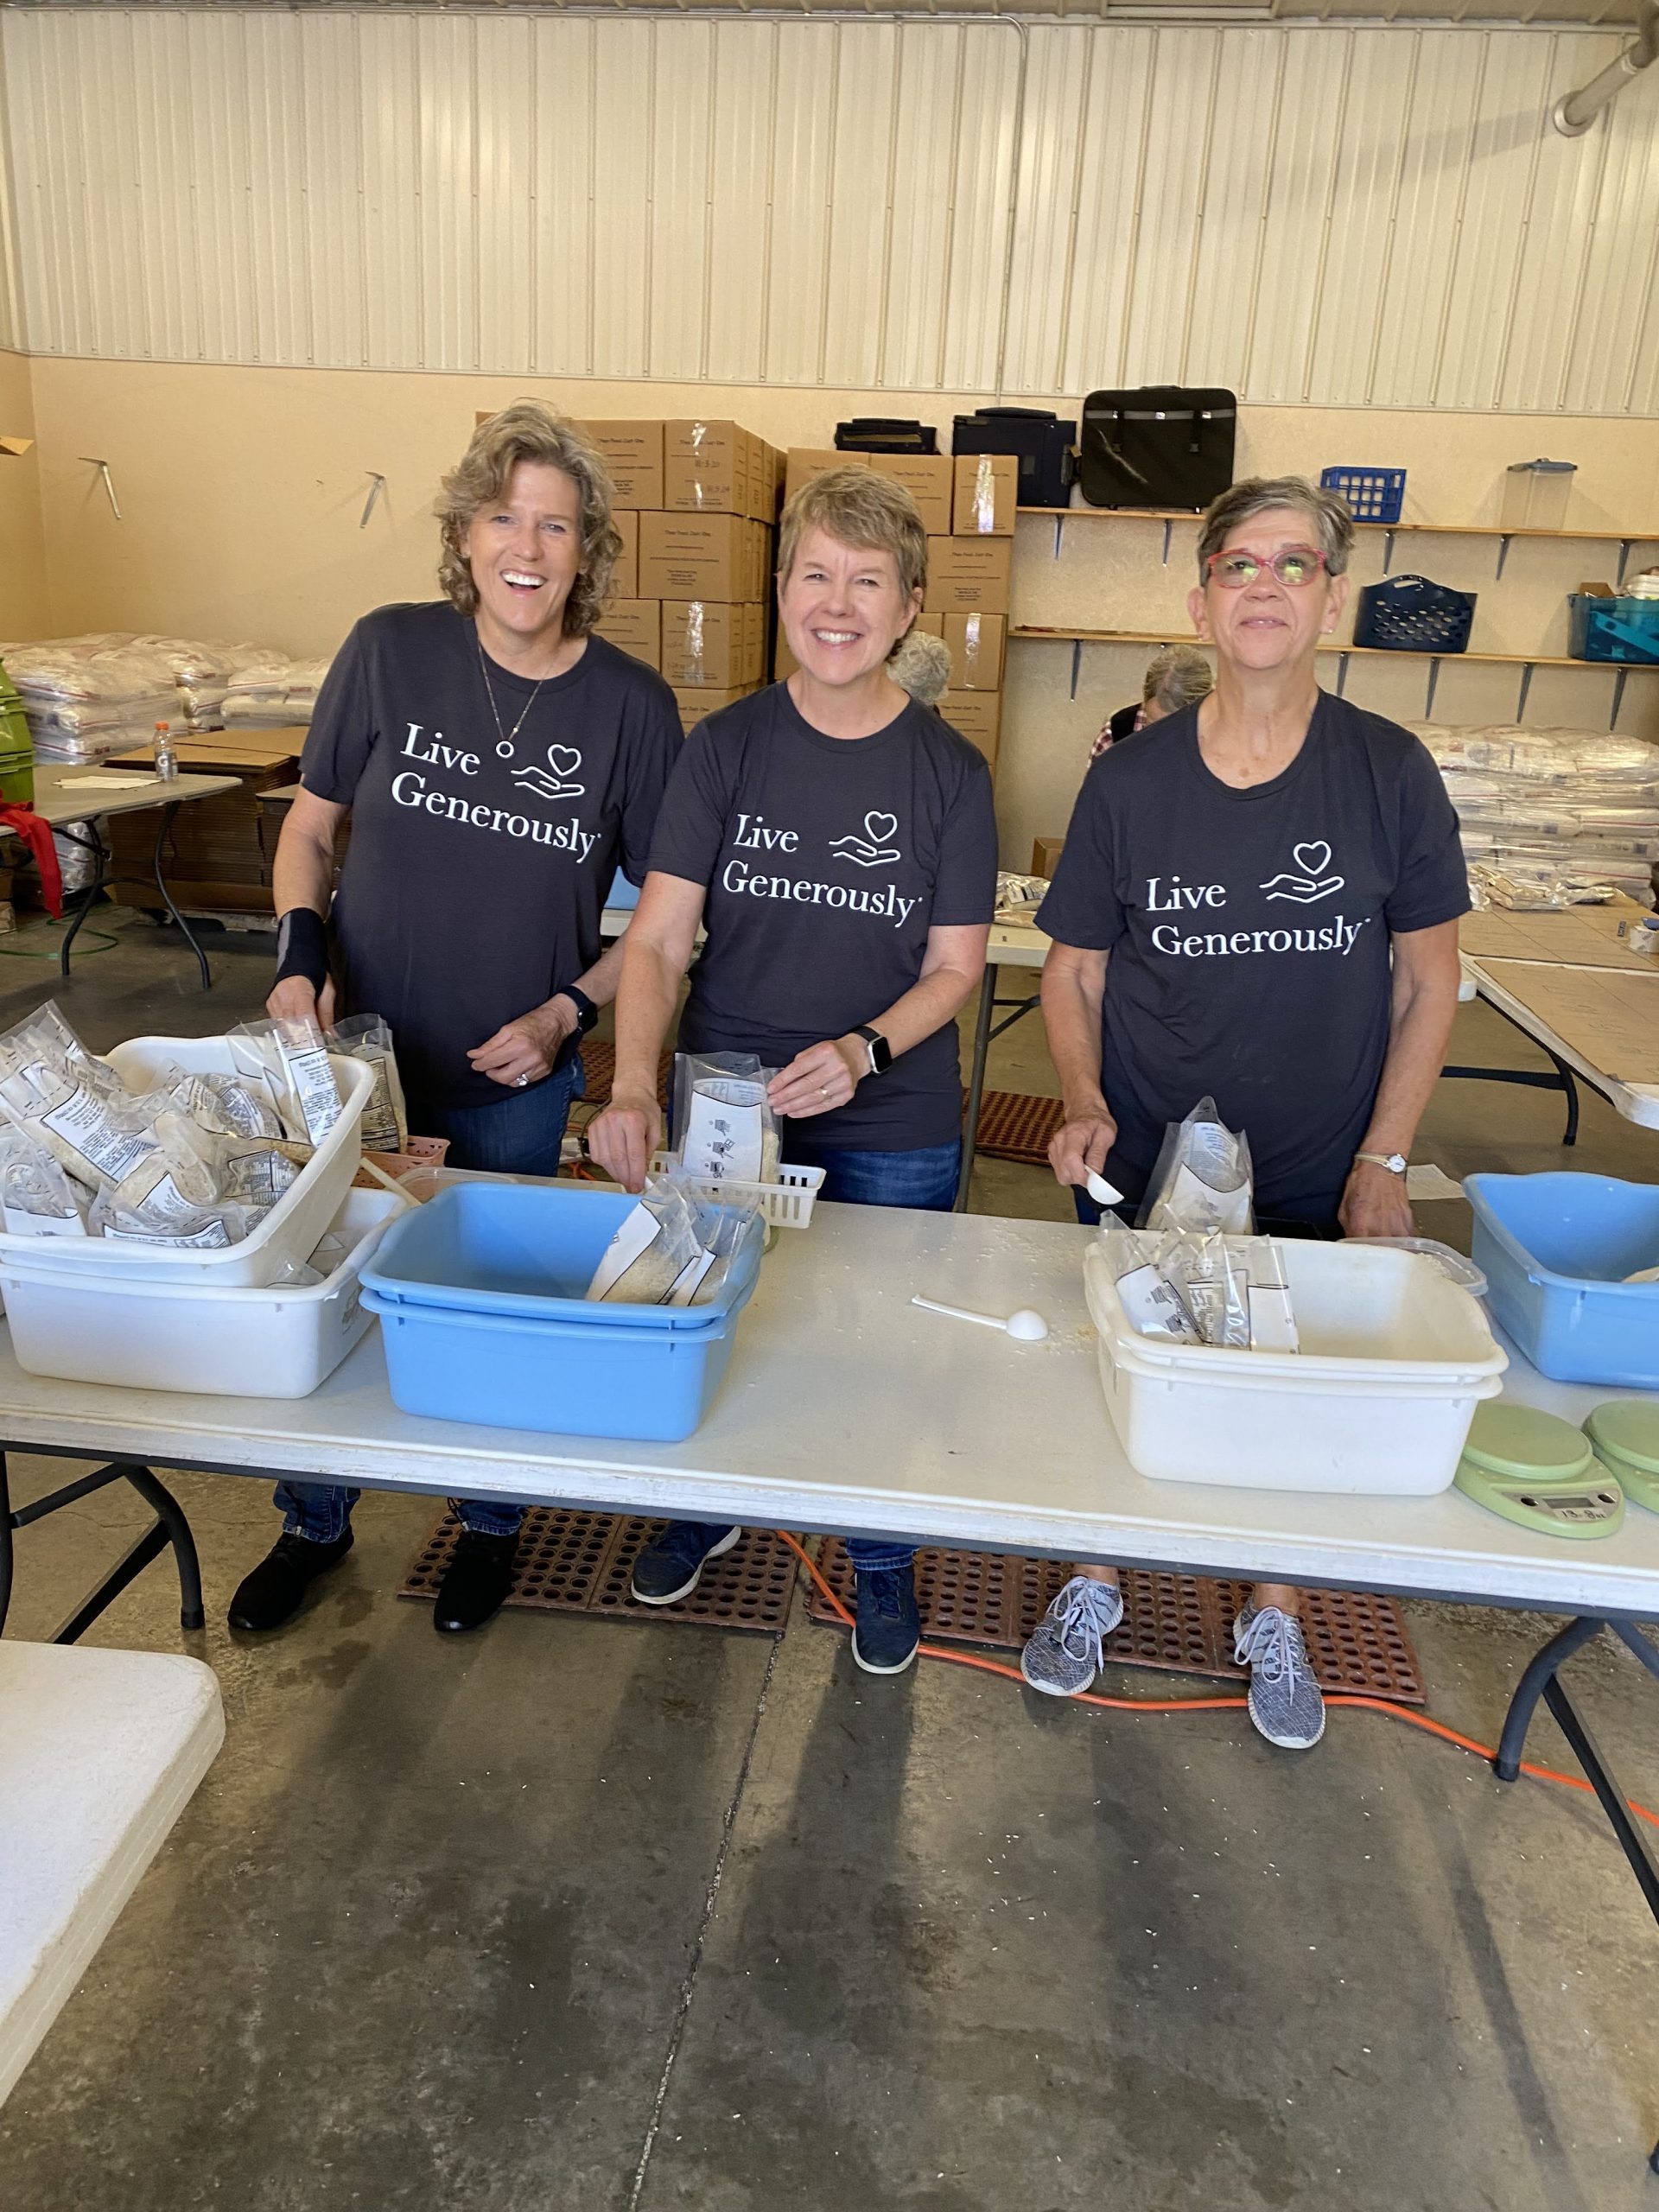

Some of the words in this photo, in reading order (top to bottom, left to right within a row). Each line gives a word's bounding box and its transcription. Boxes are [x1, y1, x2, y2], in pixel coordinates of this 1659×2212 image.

[157, 754, 168, 767] G
[400, 722, 480, 775] Live
[391, 772, 596, 863] Generously
[733, 814, 799, 852] Live
[722, 860, 916, 928] Generously
[1146, 876, 1227, 911] Live
[1151, 915, 1363, 957] Generously
